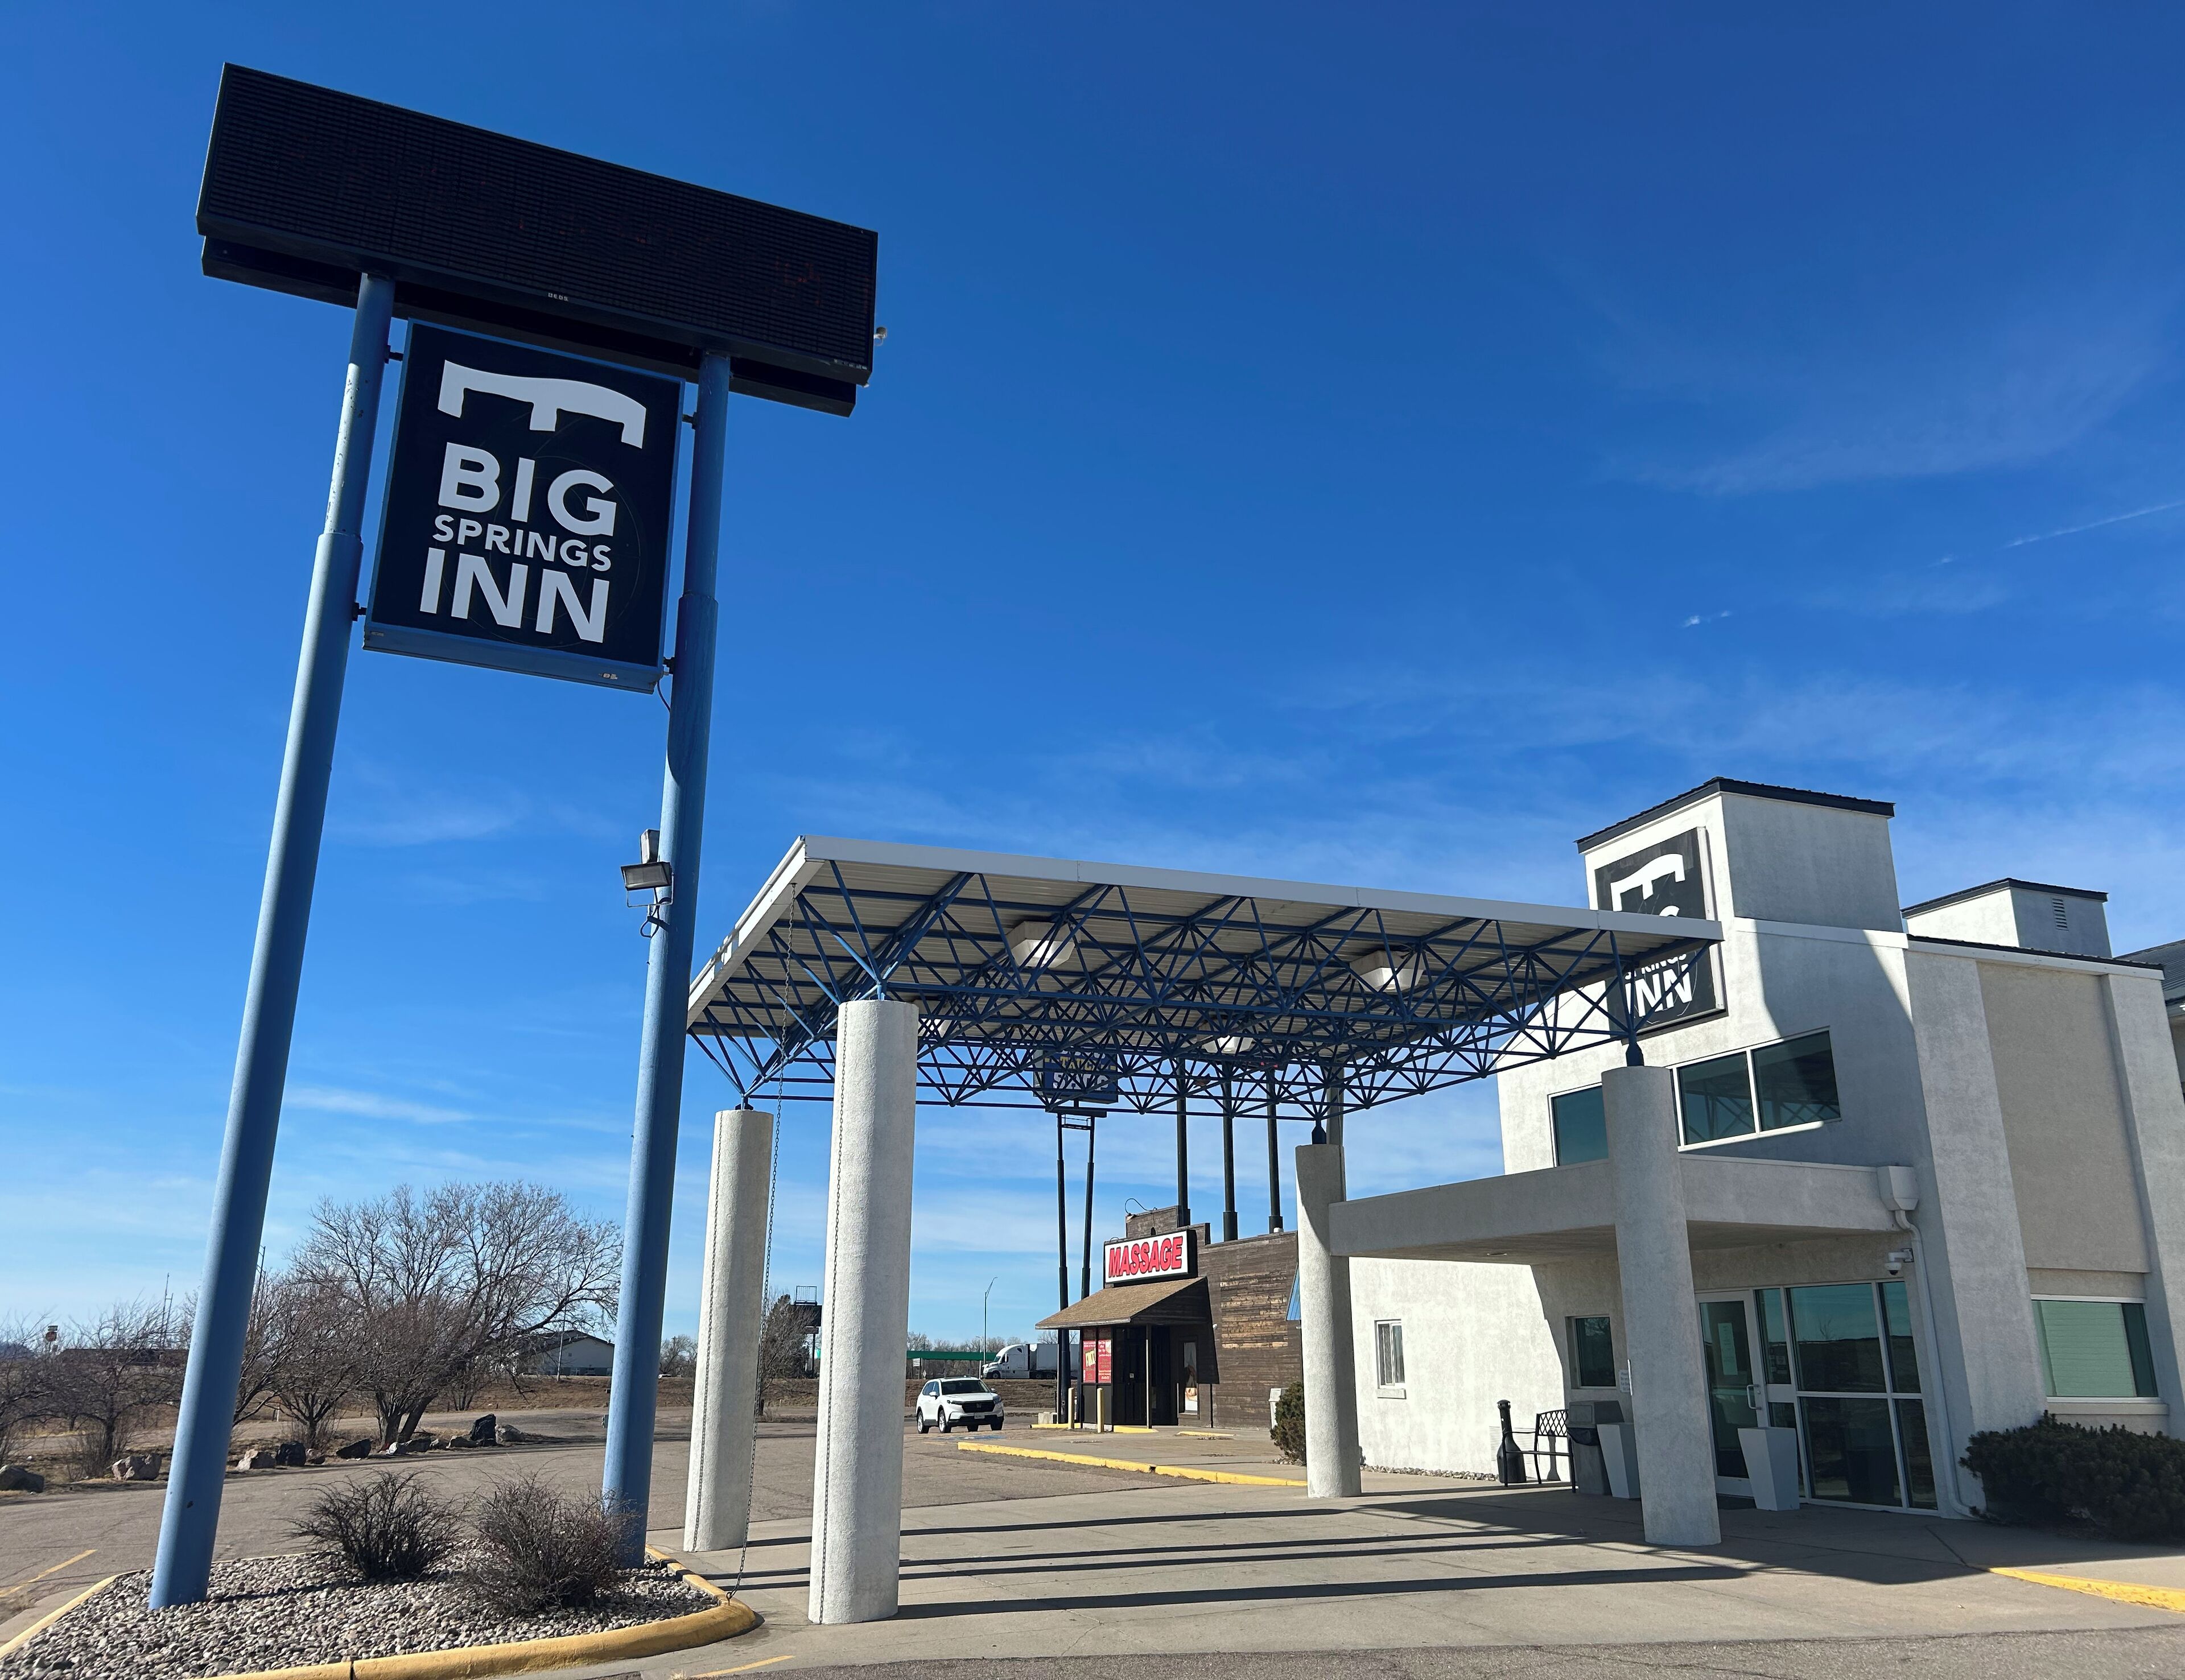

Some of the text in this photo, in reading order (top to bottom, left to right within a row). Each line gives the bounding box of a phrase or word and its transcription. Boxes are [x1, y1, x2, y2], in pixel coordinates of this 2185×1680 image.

[438, 442, 617, 536] BIG
[433, 514, 611, 571] SPRINGS
[420, 547, 609, 643] INN
[1625, 963, 1693, 1018] INN
[1108, 1236, 1183, 1278] MASSAGE
